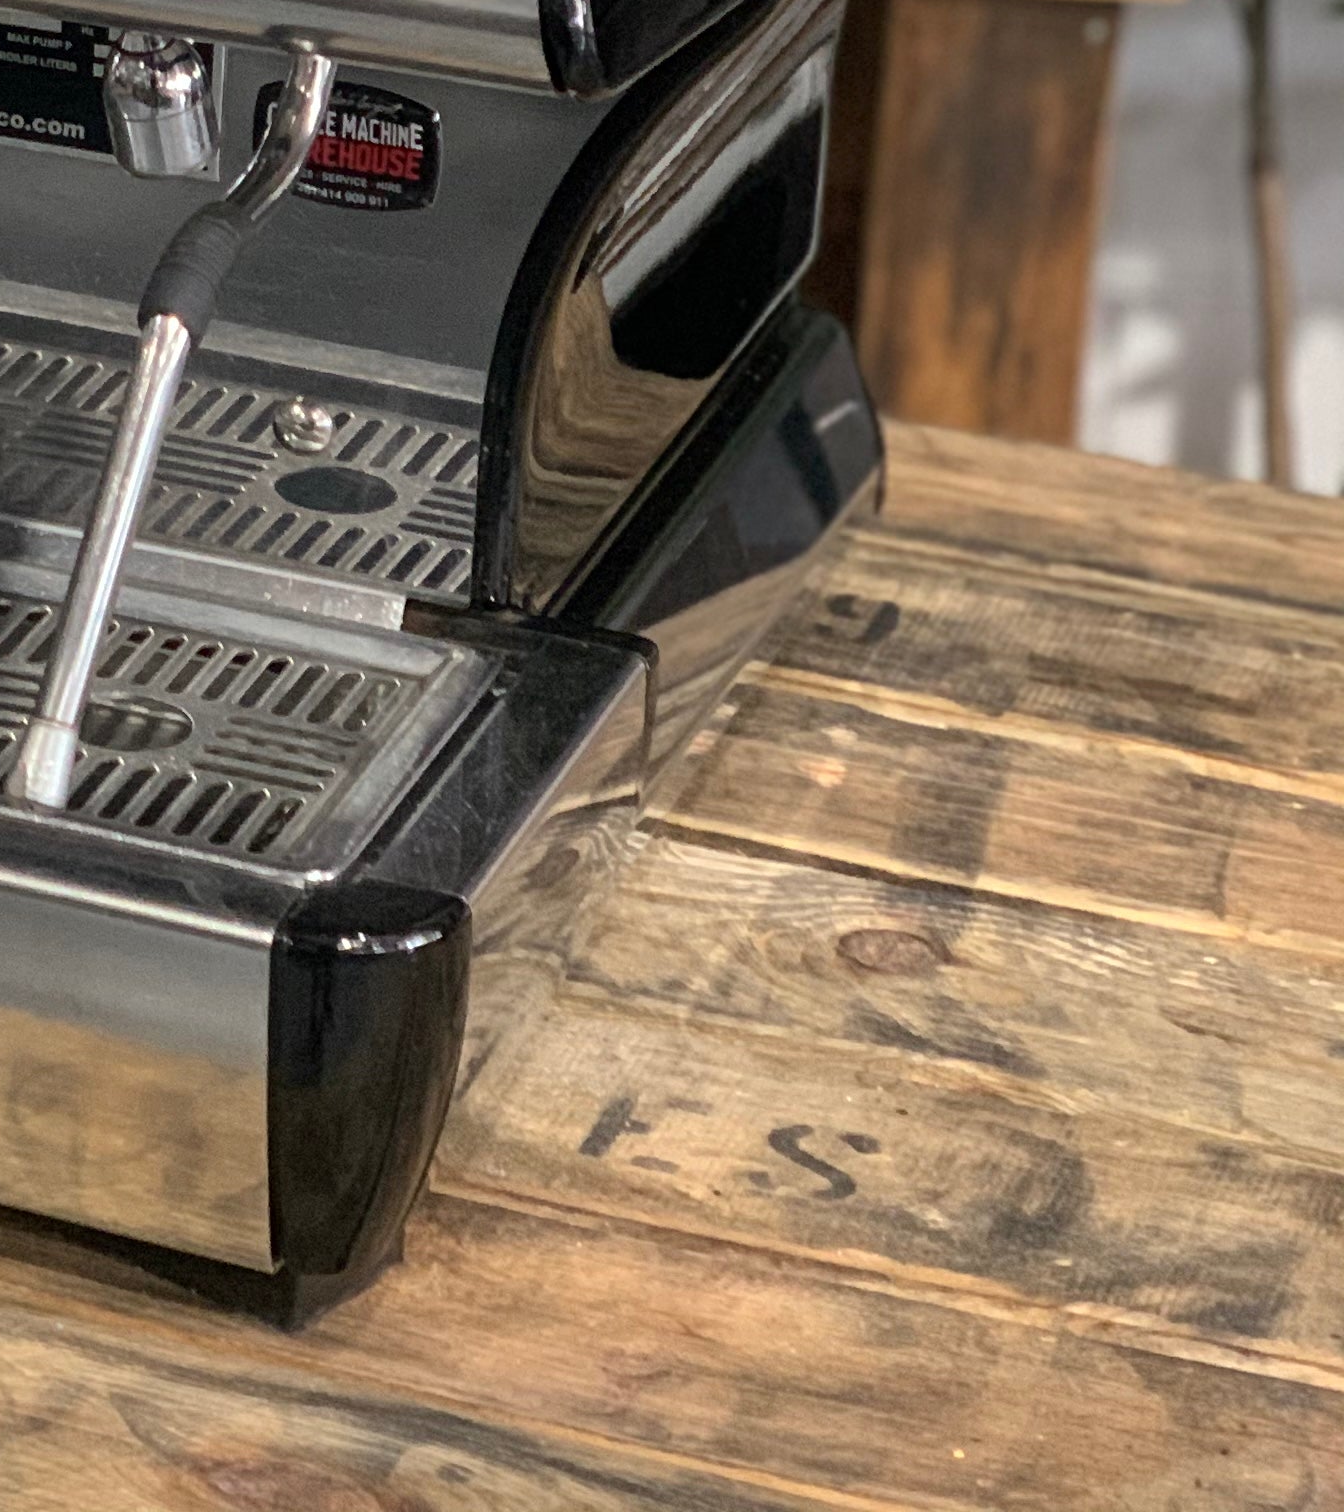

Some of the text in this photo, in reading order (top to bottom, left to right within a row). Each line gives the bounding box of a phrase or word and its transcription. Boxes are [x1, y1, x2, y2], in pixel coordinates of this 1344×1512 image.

[6, 31, 30, 44] MAX
[32, 36, 62, 50] PUMP
[40, 57, 78, 73] LITERS
[341, 112, 425, 152] MACHINE
[321, 171, 368, 189] SERVICE
